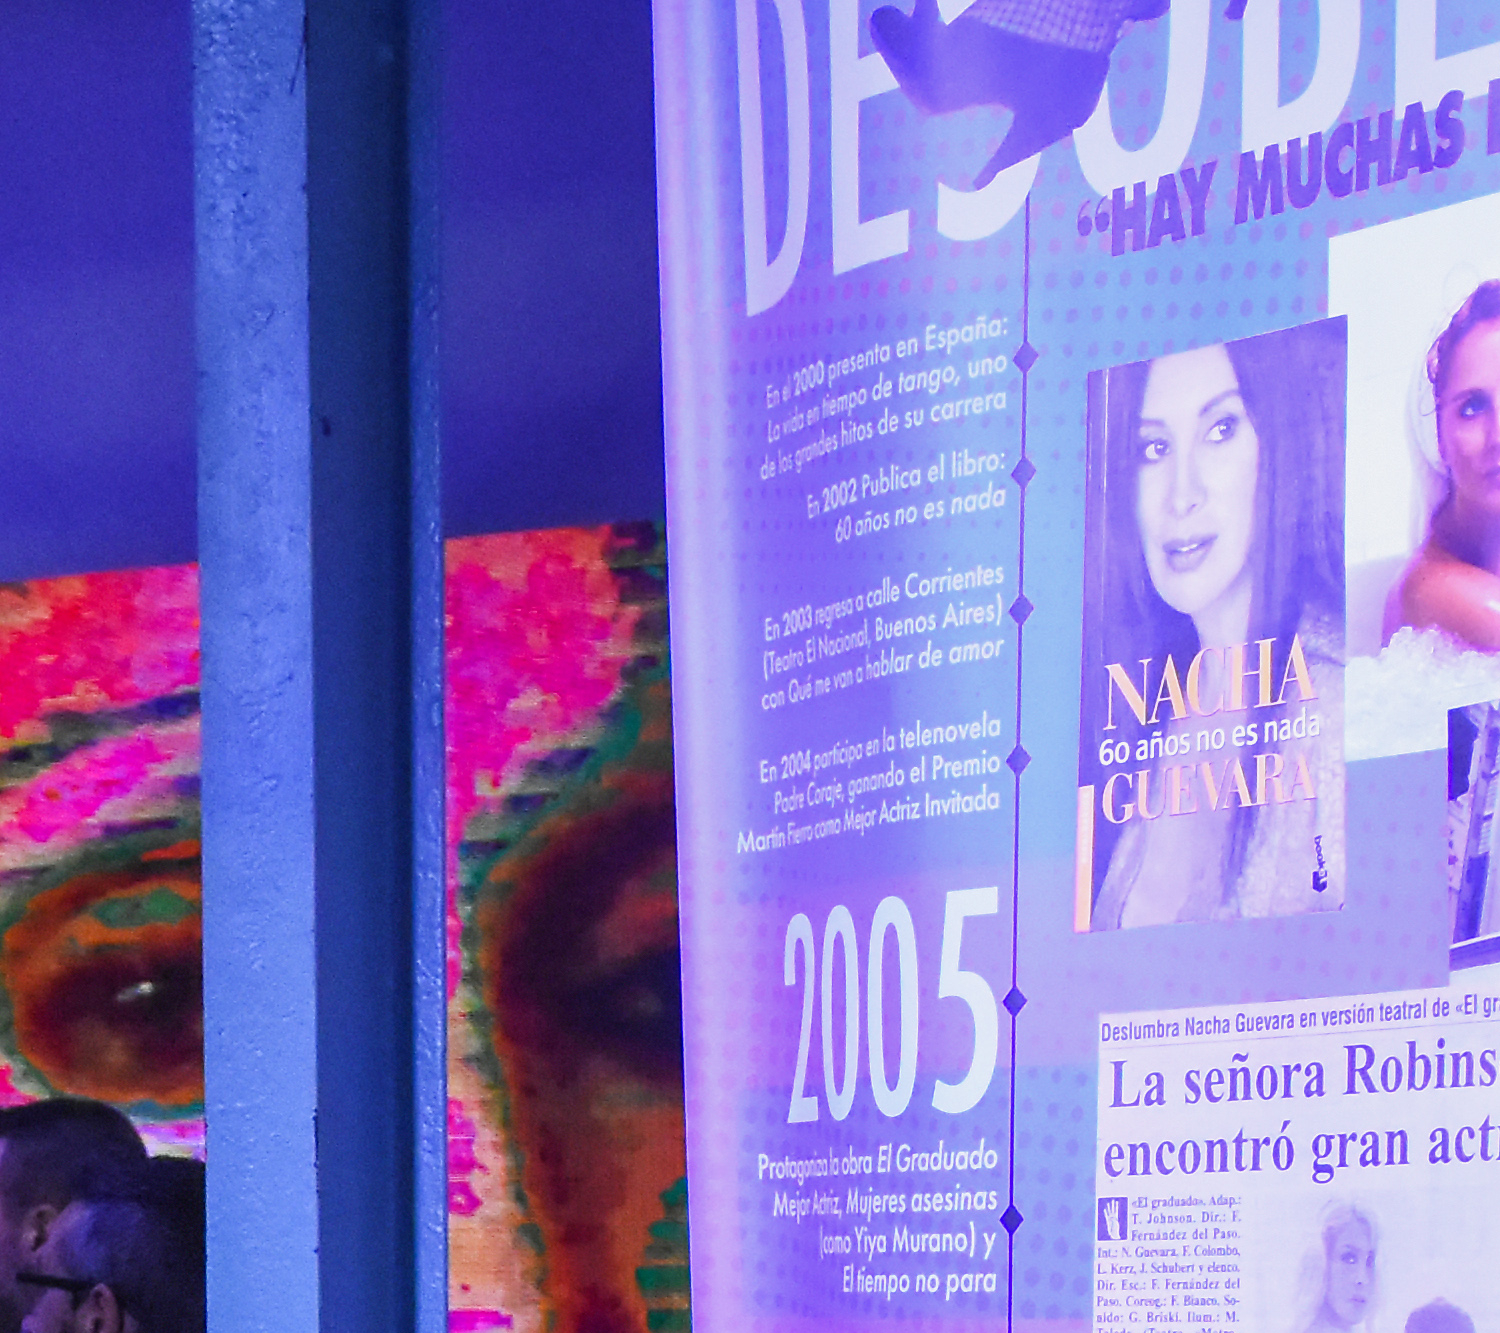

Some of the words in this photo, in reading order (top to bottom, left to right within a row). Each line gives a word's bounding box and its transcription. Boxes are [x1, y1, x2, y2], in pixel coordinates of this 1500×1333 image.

[1234, 90, 1465, 224] MUCHAS
[793, 360, 825, 396] 2000
[828, 343, 890, 388] presenta
[896, 337, 918, 358] en
[925, 315, 1008, 354] España:
[823, 477, 858, 512] 2002
[861, 463, 921, 499] Publica
[927, 453, 944, 483] el
[952, 449, 1006, 478] libro:
[835, 515, 852, 544] 60
[855, 510, 890, 537] años
[894, 505, 917, 526] no
[923, 499, 945, 520] es
[951, 480, 1006, 515] nada
[764, 616, 780, 642] En
[783, 604, 813, 637] 2003
[866, 576, 900, 609] calle
[904, 564, 1004, 598] Corrientes
[874, 613, 936, 642] Buenos
[942, 592, 1002, 629] Aires)
[1102, 633, 1319, 732] NACHA
[1099, 738, 1130, 766] 60
[1135, 731, 1191, 760] años
[1196, 728, 1225, 753] no
[1232, 723, 1258, 746] es
[1264, 707, 1320, 743] nada
[1102, 751, 1318, 825] GUEVARA
[784, 886, 999, 1124] 2005
[1101, 1013, 1180, 1042] Deslumbra
[1184, 1015, 1231, 1038] Nacha
[1235, 1010, 1294, 1034] Guevara
[1299, 1011, 1317, 1029] en
[1321, 1002, 1375, 1028] versión
[1379, 997, 1428, 1022] teatral
[1433, 995, 1451, 1019] de
[1455, 991, 1479, 1016] «El
[1109, 1059, 1166, 1109] La
[1184, 1052, 1326, 1106] señora
[1103, 1120, 1295, 1179] encontró
[1311, 1127, 1411, 1184] gran
[1192, 1228, 1208, 1240] del
[1213, 1228, 1241, 1240] Paso.
[856, 1268, 910, 1301] tiempo
[915, 1271, 940, 1294] no
[945, 1269, 998, 1301] para
